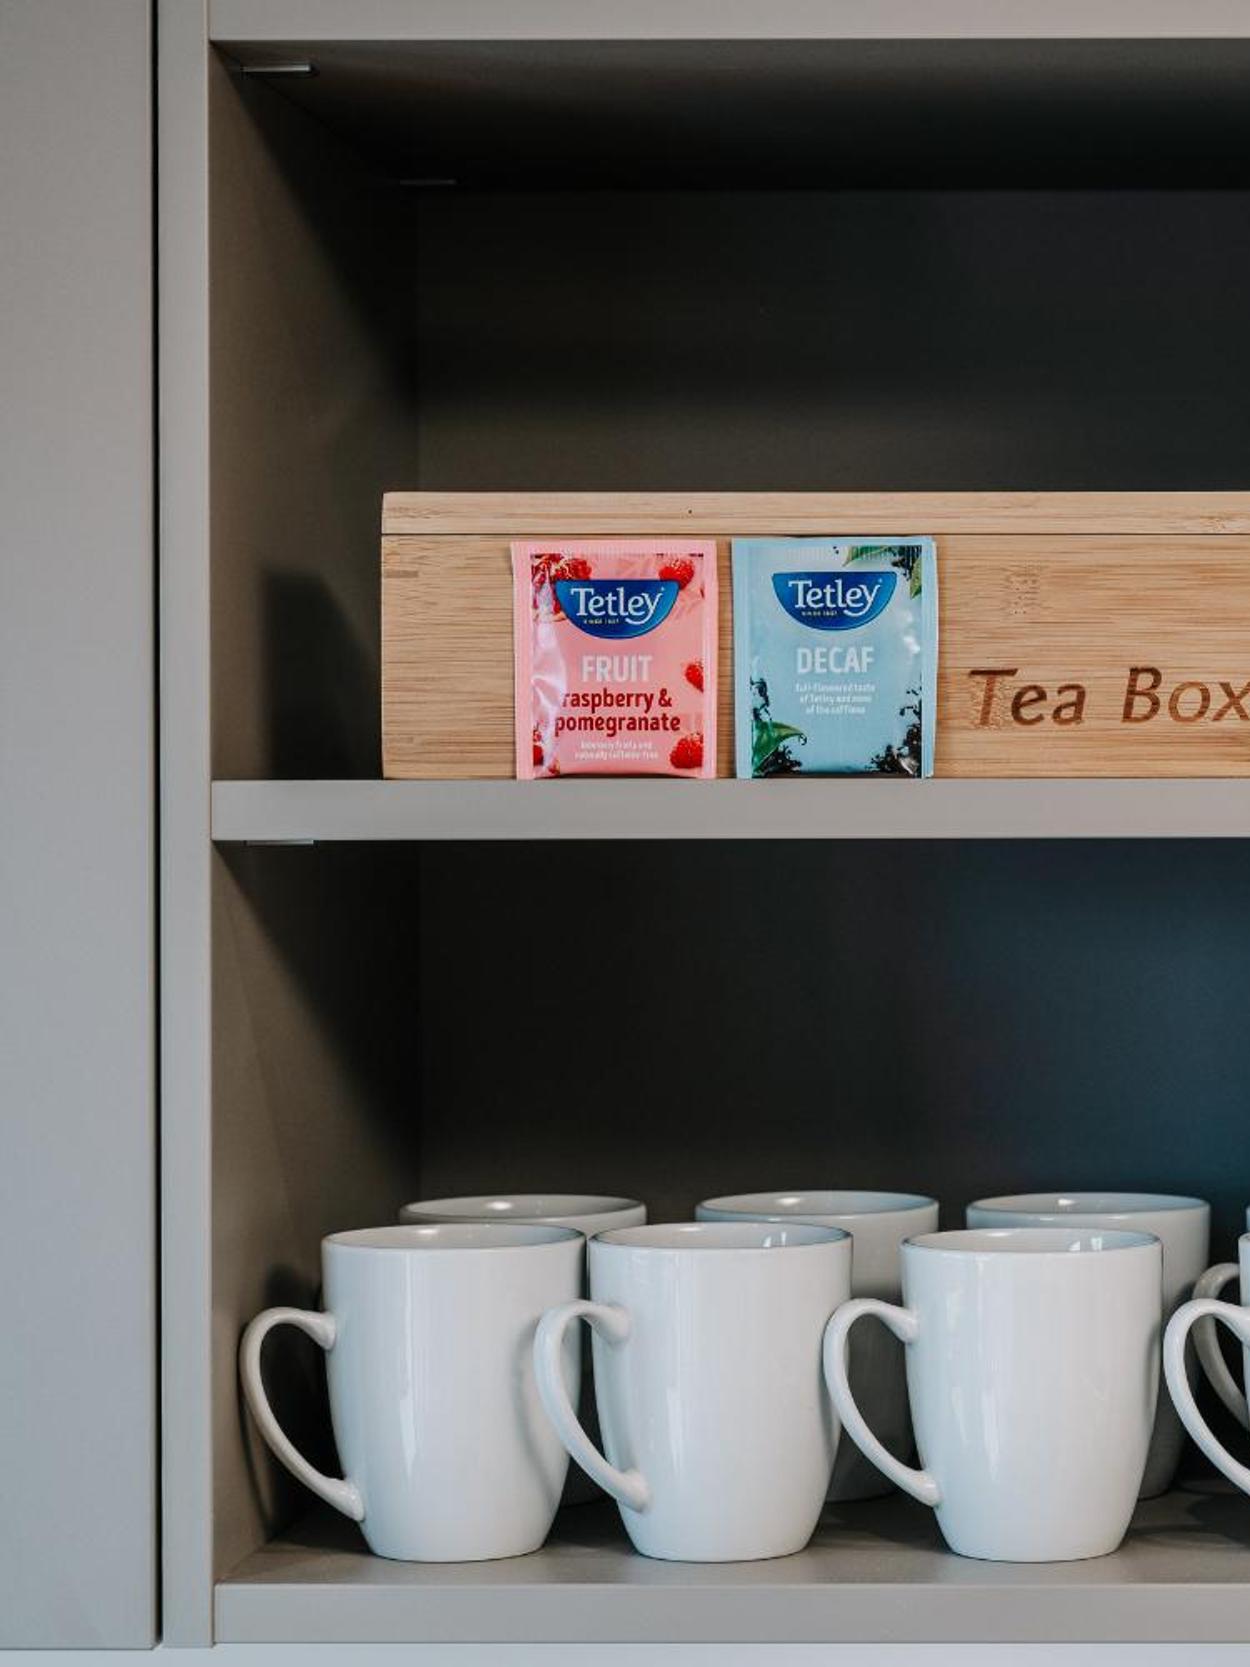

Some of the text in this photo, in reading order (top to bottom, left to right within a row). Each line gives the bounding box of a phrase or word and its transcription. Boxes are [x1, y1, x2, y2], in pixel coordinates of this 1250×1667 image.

[570, 586, 662, 625] Tetley
[787, 578, 882, 617] Tetley
[580, 654, 653, 683] FRUIT
[796, 646, 875, 674] DECAF
[562, 688, 673, 713] raspberry &
[968, 667, 1086, 726] Tea
[554, 713, 681, 738] pomegranate
